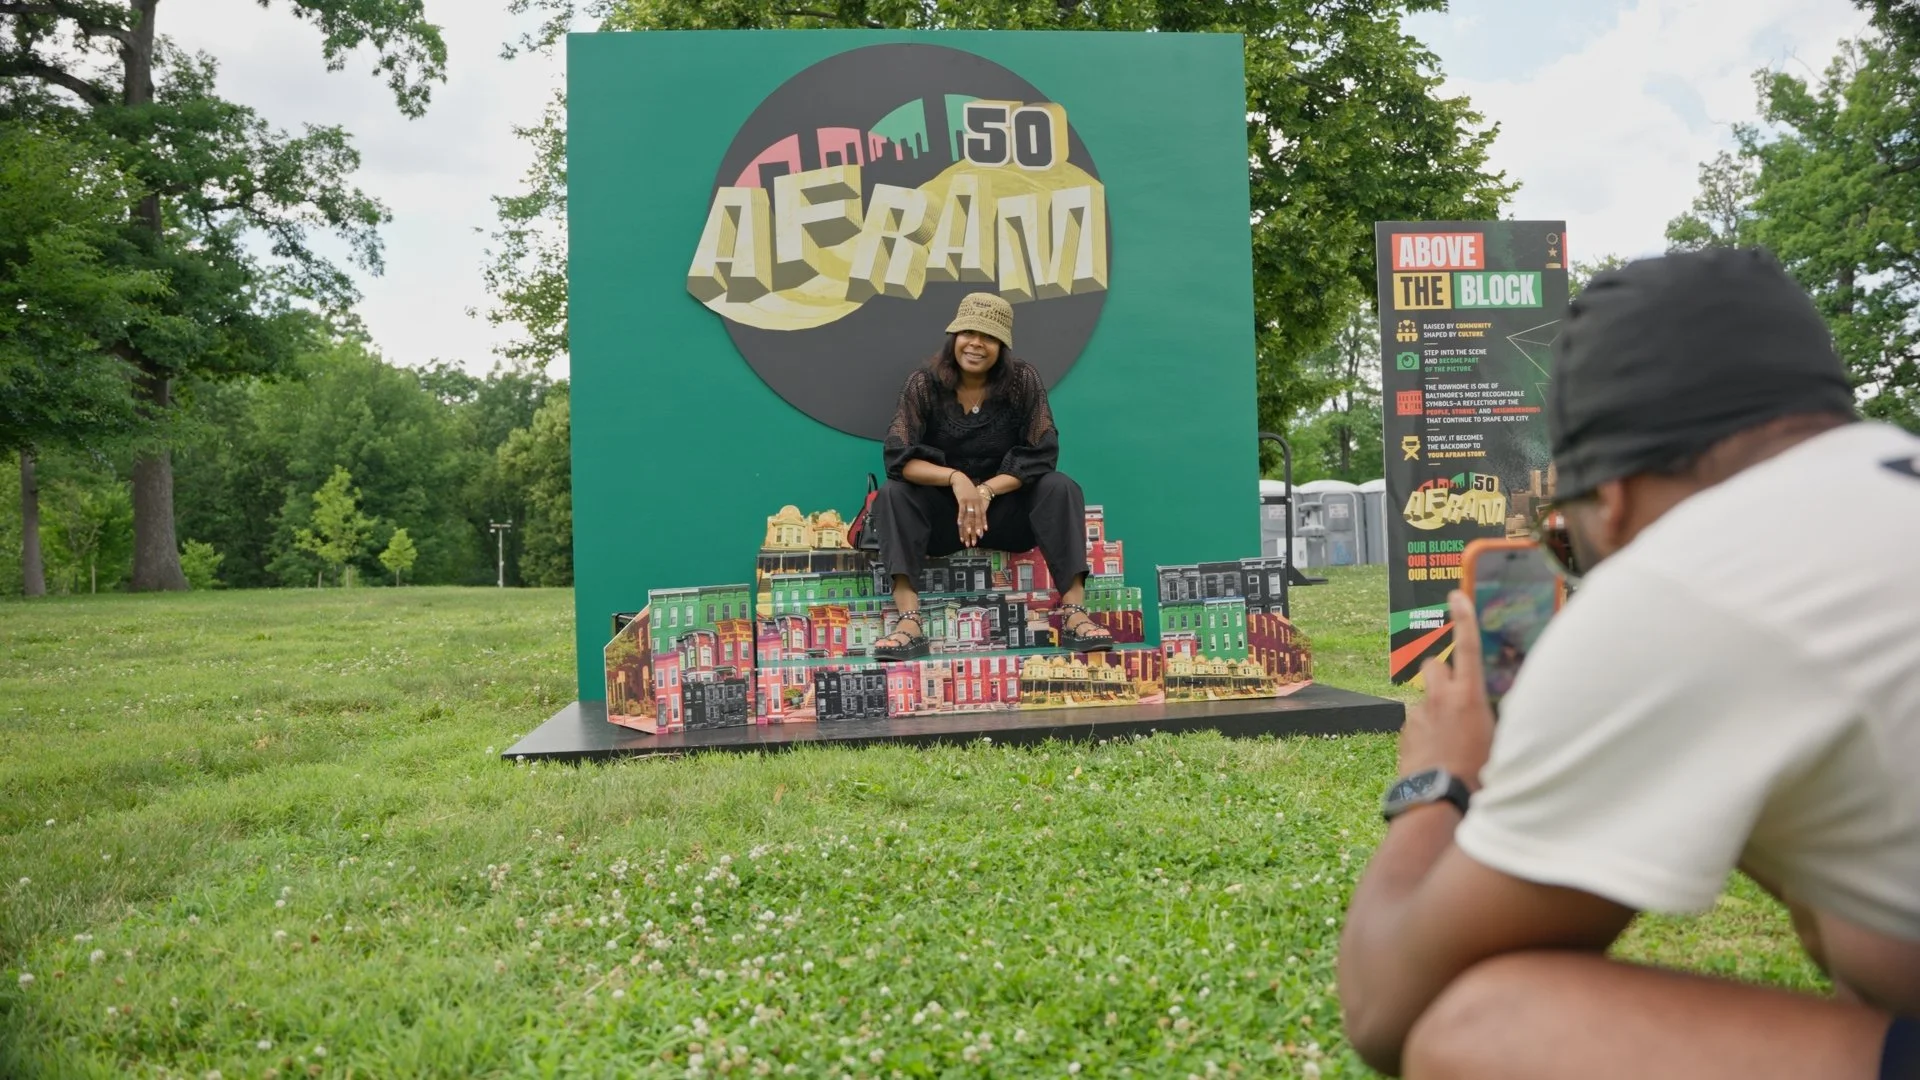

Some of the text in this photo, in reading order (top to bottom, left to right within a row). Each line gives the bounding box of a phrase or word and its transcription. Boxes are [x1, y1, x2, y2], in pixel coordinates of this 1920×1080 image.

[964, 101, 1060, 171] 50
[687, 165, 1107, 303] AFRAM
[1399, 236, 1476, 267] ABOVE
[1400, 274, 1536, 306] THE BLOCK
[1473, 475, 1496, 493] 50
[1404, 487, 1507, 527] AFRAM
[1408, 540, 1465, 554] OUR BLOCKS
[1408, 554, 1427, 567] OUR
[1408, 568, 1428, 581] OUR
